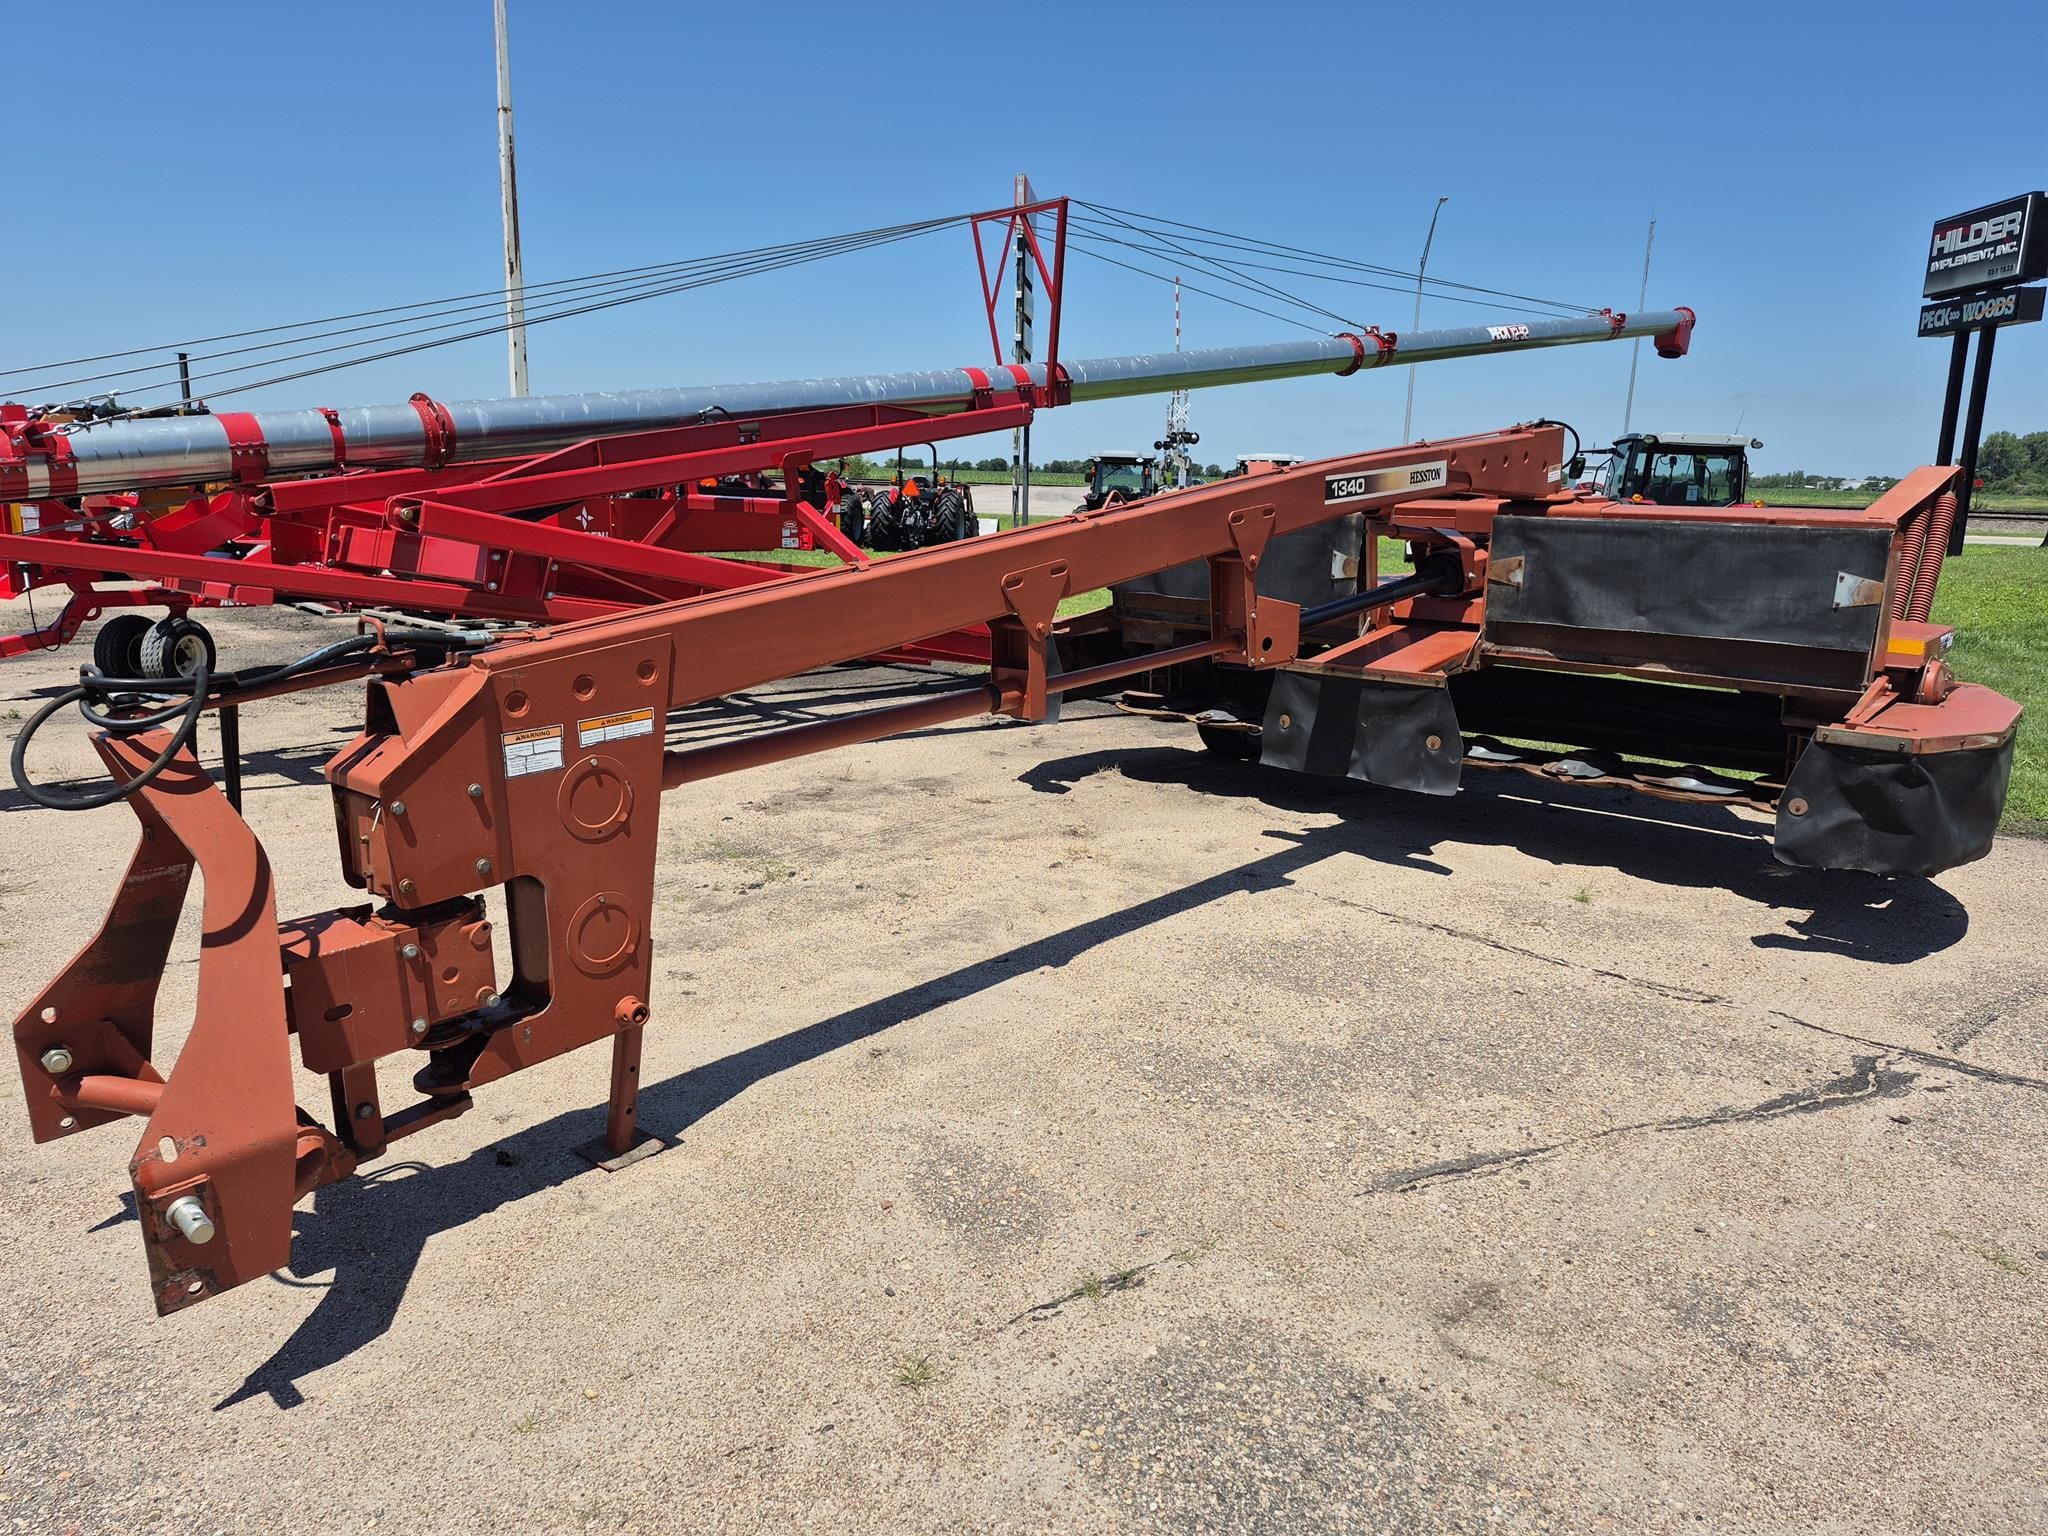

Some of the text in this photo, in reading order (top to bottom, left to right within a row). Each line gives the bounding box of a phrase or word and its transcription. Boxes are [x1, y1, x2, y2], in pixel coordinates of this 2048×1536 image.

[1932, 211, 2022, 257] HILDER
[1930, 241, 2018, 272] IMPLEMENT, INC.
[1920, 294, 2016, 330] PECK WOODS
[1331, 467, 1442, 497] 1340 HESSTON
[520, 729, 551, 741] WARNING
[605, 715, 633, 726] WARNING
